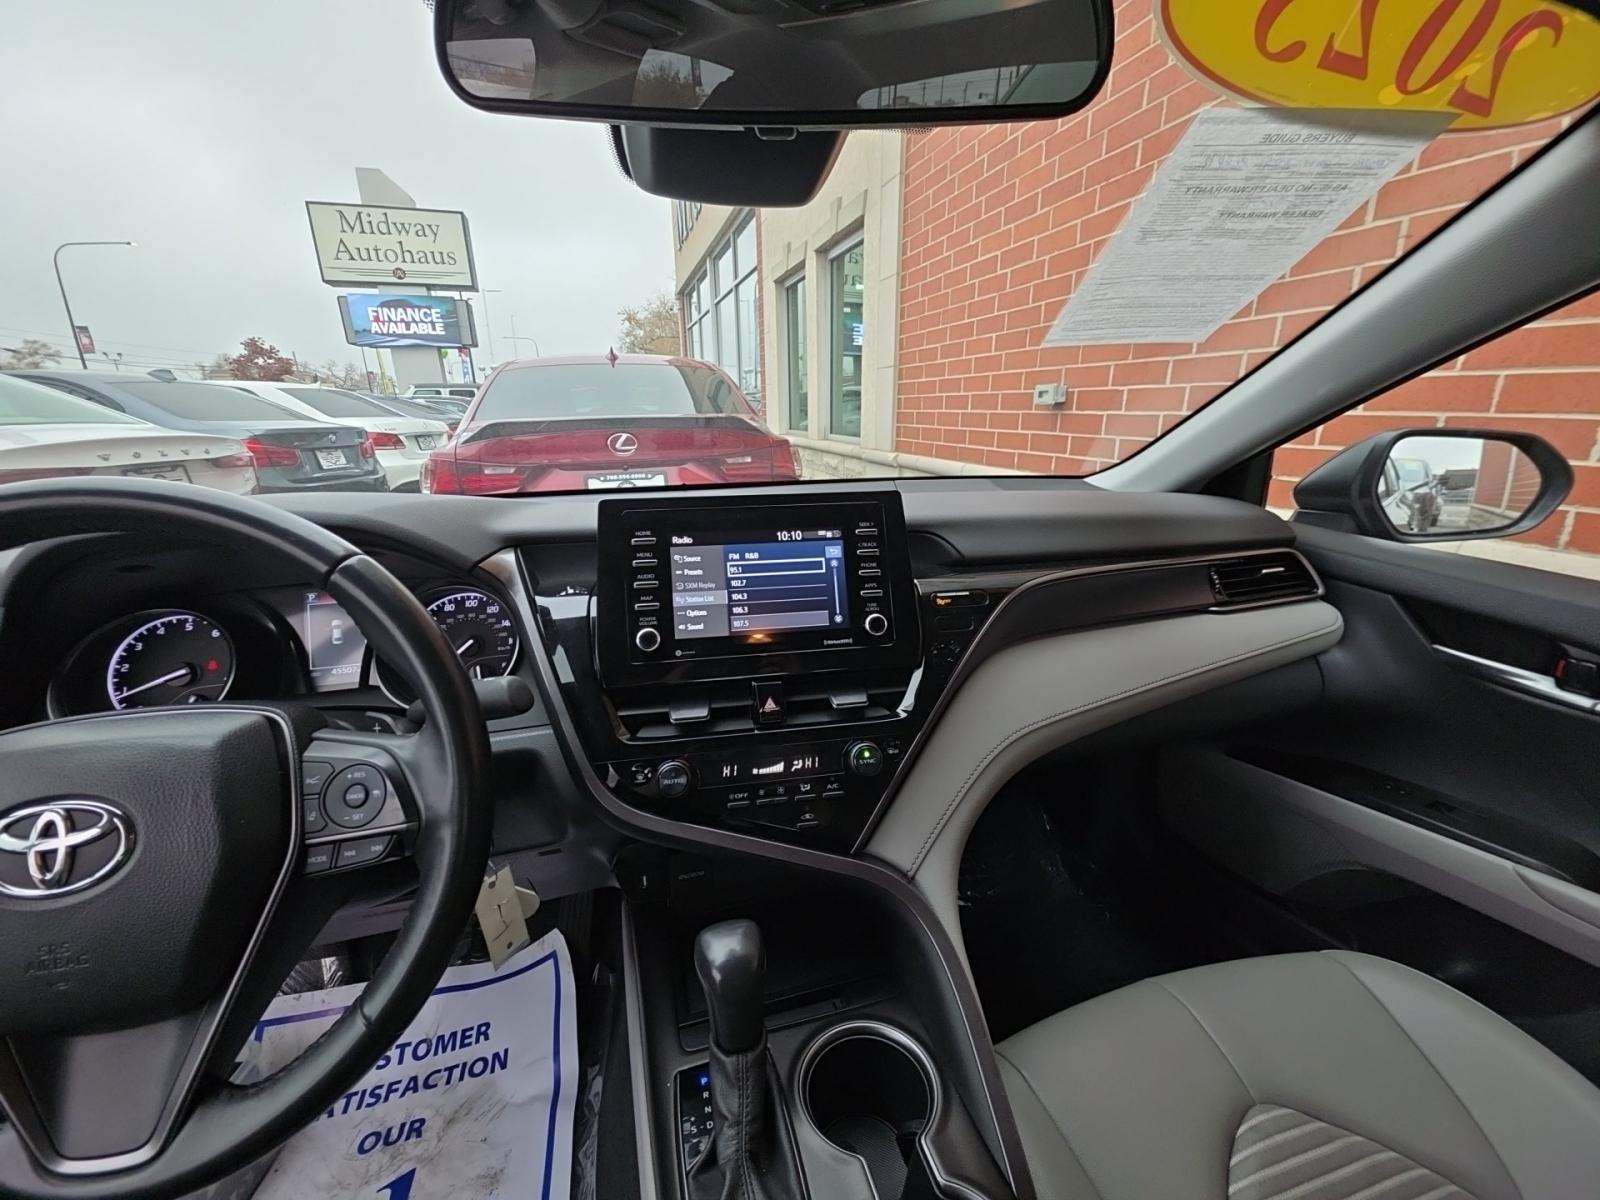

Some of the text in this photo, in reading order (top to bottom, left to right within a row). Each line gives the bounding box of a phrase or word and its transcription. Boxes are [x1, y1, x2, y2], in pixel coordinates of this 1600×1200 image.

[336, 209, 441, 243] Midway
[334, 238, 457, 266] Autohaus
[367, 307, 443, 322] FINANCE
[371, 322, 446, 335] AVAILABLE
[672, 530, 802, 545] Radio 10:10
[683, 555, 701, 563] Source
[745, 552, 759, 560] R&B
[684, 568, 703, 576] Presets
[308, 594, 316, 602] P
[444, 604, 455, 612] 80
[465, 600, 478, 608] 100
[686, 609, 707, 617] Options
[184, 622, 193, 631] 5
[687, 623, 704, 631] Sound
[733, 620, 749, 628] 107.5
[156, 627, 165, 635] 4
[211, 629, 220, 637] 6
[134, 642, 143, 651] 3
[120, 664, 130, 672] 2
[663, 777, 685, 785] AUTO
[734, 792, 749, 800] OFF
[351, 813, 364, 821] SET
[375, 1021, 492, 1071] STOMER
[357, 1117, 427, 1155] OUR
